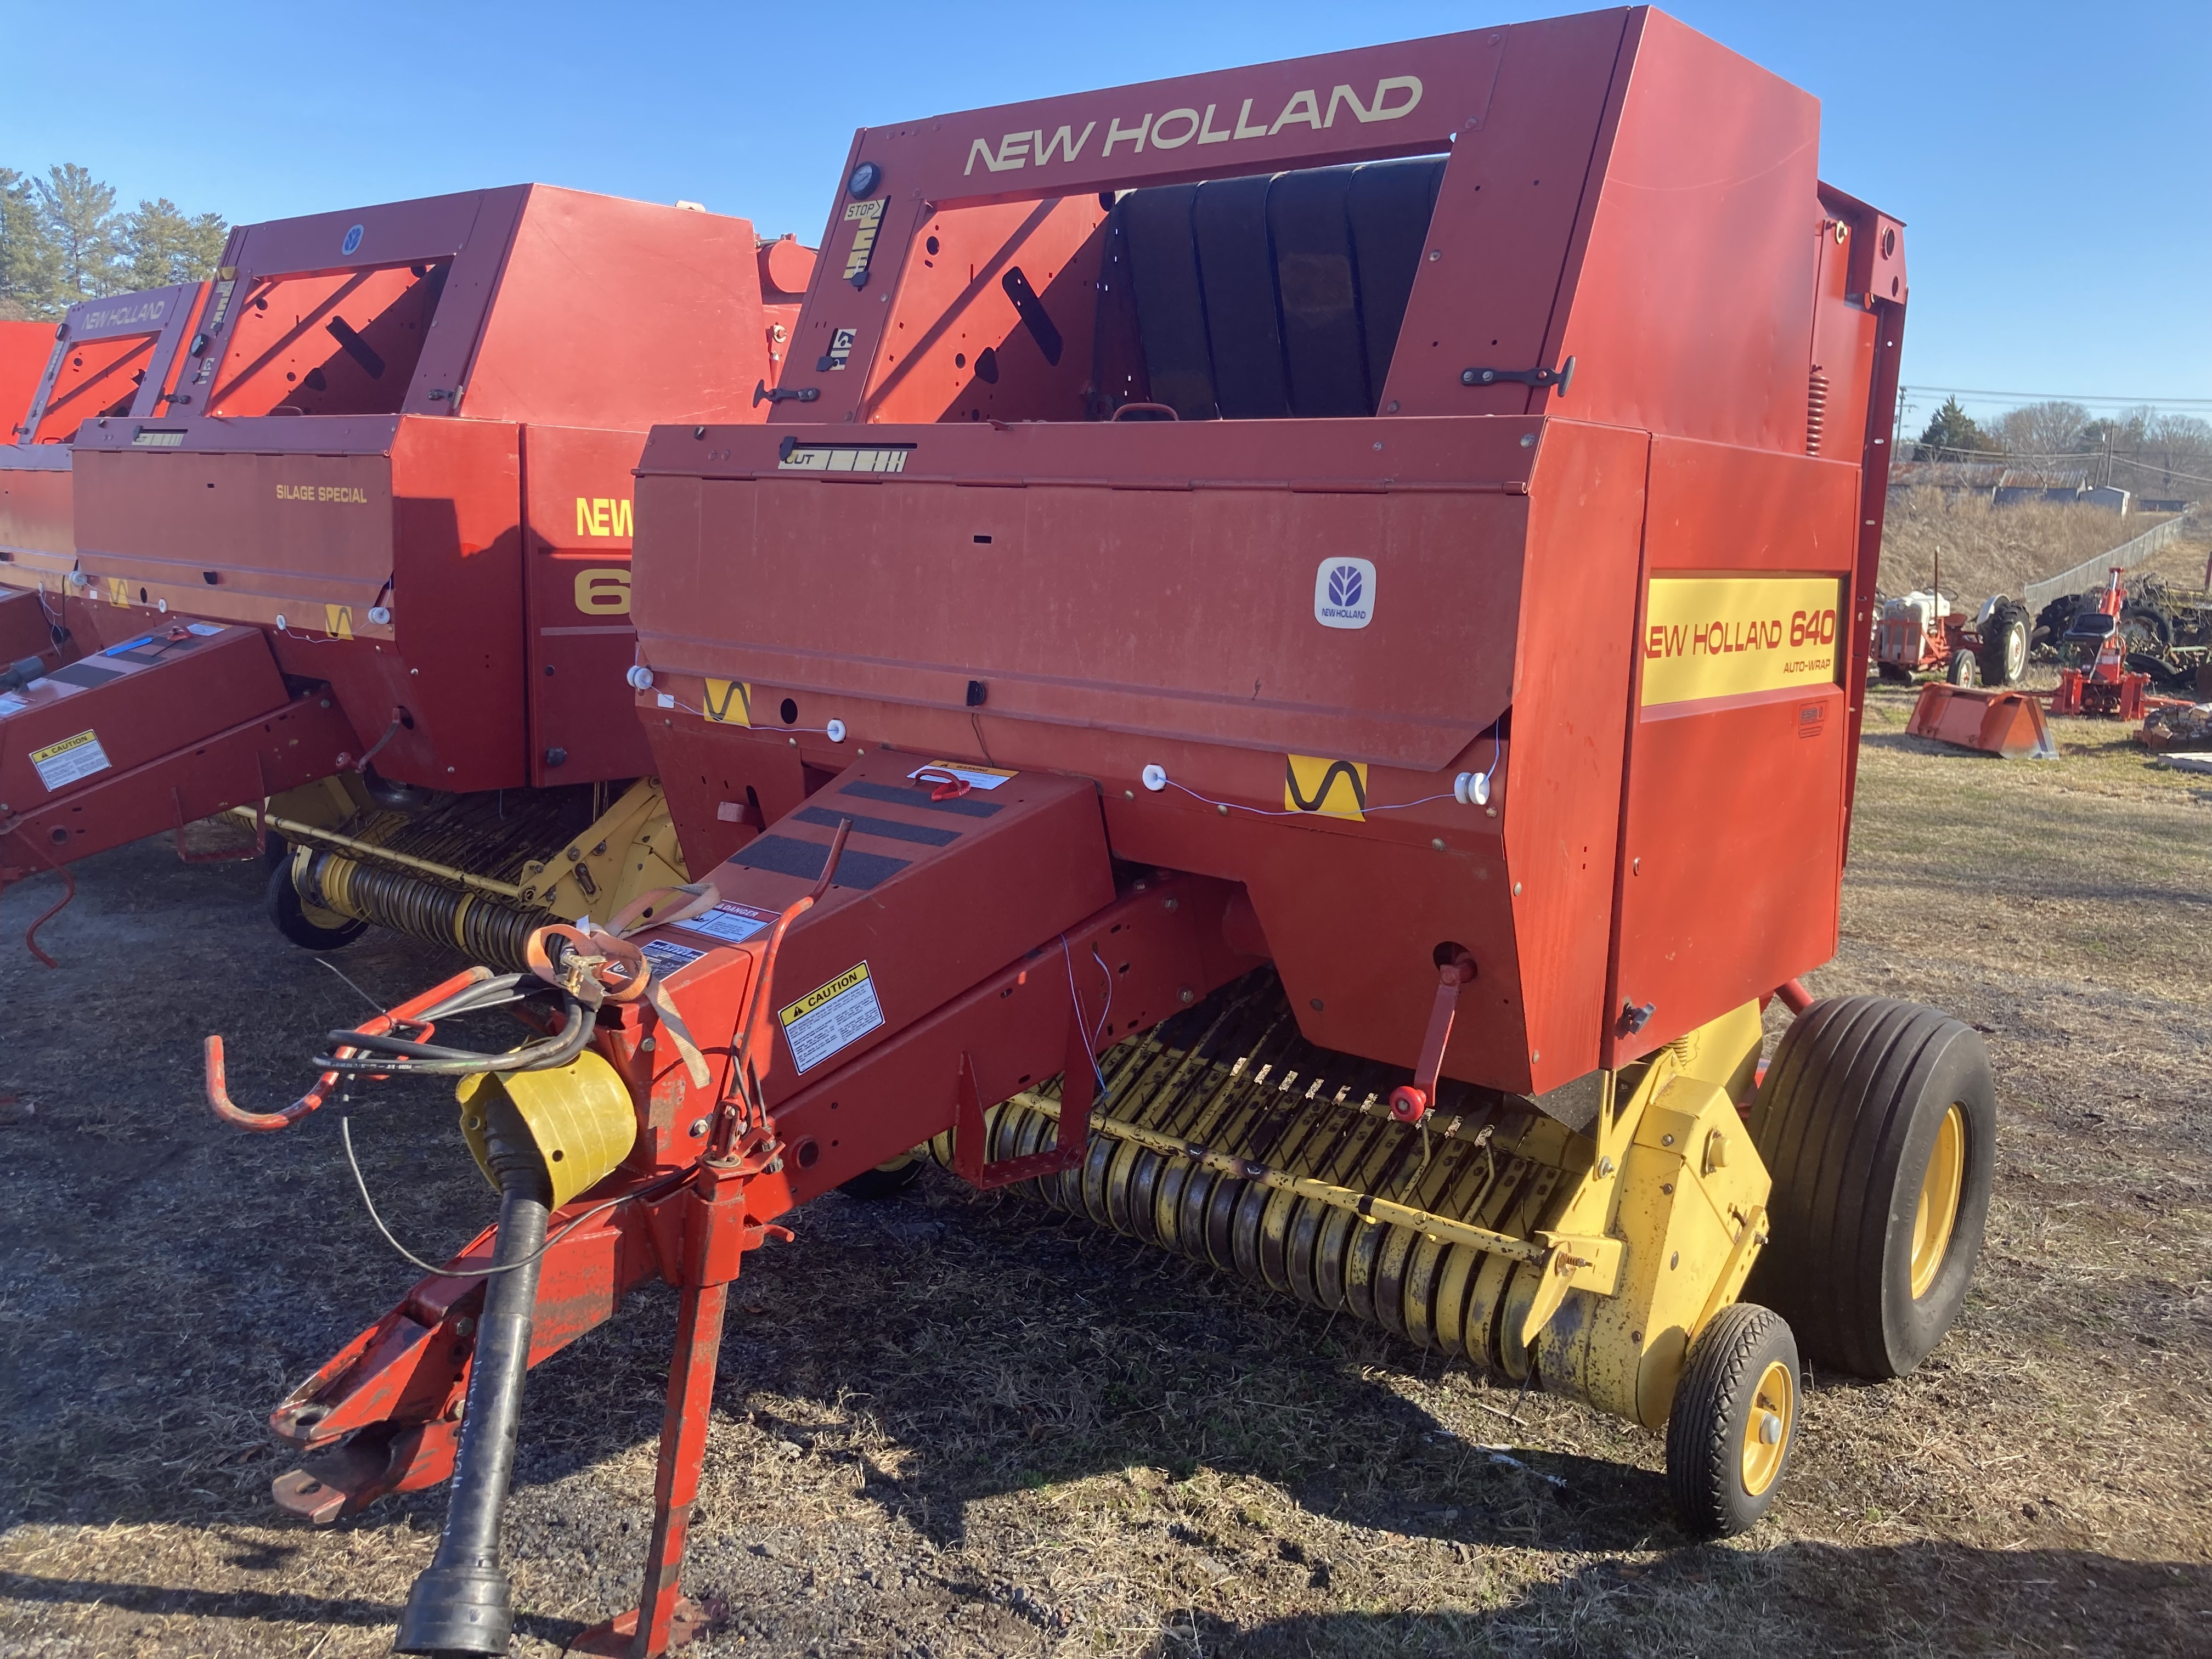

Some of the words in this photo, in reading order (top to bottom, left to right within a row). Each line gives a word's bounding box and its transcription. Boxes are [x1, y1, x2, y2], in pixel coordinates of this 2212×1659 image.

[963, 121, 1097, 176] NEW
[1102, 75, 1424, 158] HOLLAND
[847, 204, 874, 217] STOP
[81, 310, 111, 330] NEW
[107, 301, 165, 327] HOLLAND
[276, 484, 315, 501] SILAGE
[318, 486, 368, 504] SPECIAL
[1322, 608, 1336, 617] NEW
[1336, 609, 1366, 619] HOLLAND
[1692, 620, 1782, 656] HOLLAND
[1790, 610, 1837, 647] 640
[1783, 659, 1831, 674] AUTO-WRAP
[52, 735, 88, 754] CAUTION
[721, 905, 759, 917] DANGER
[808, 972, 857, 1007] CAUTION
